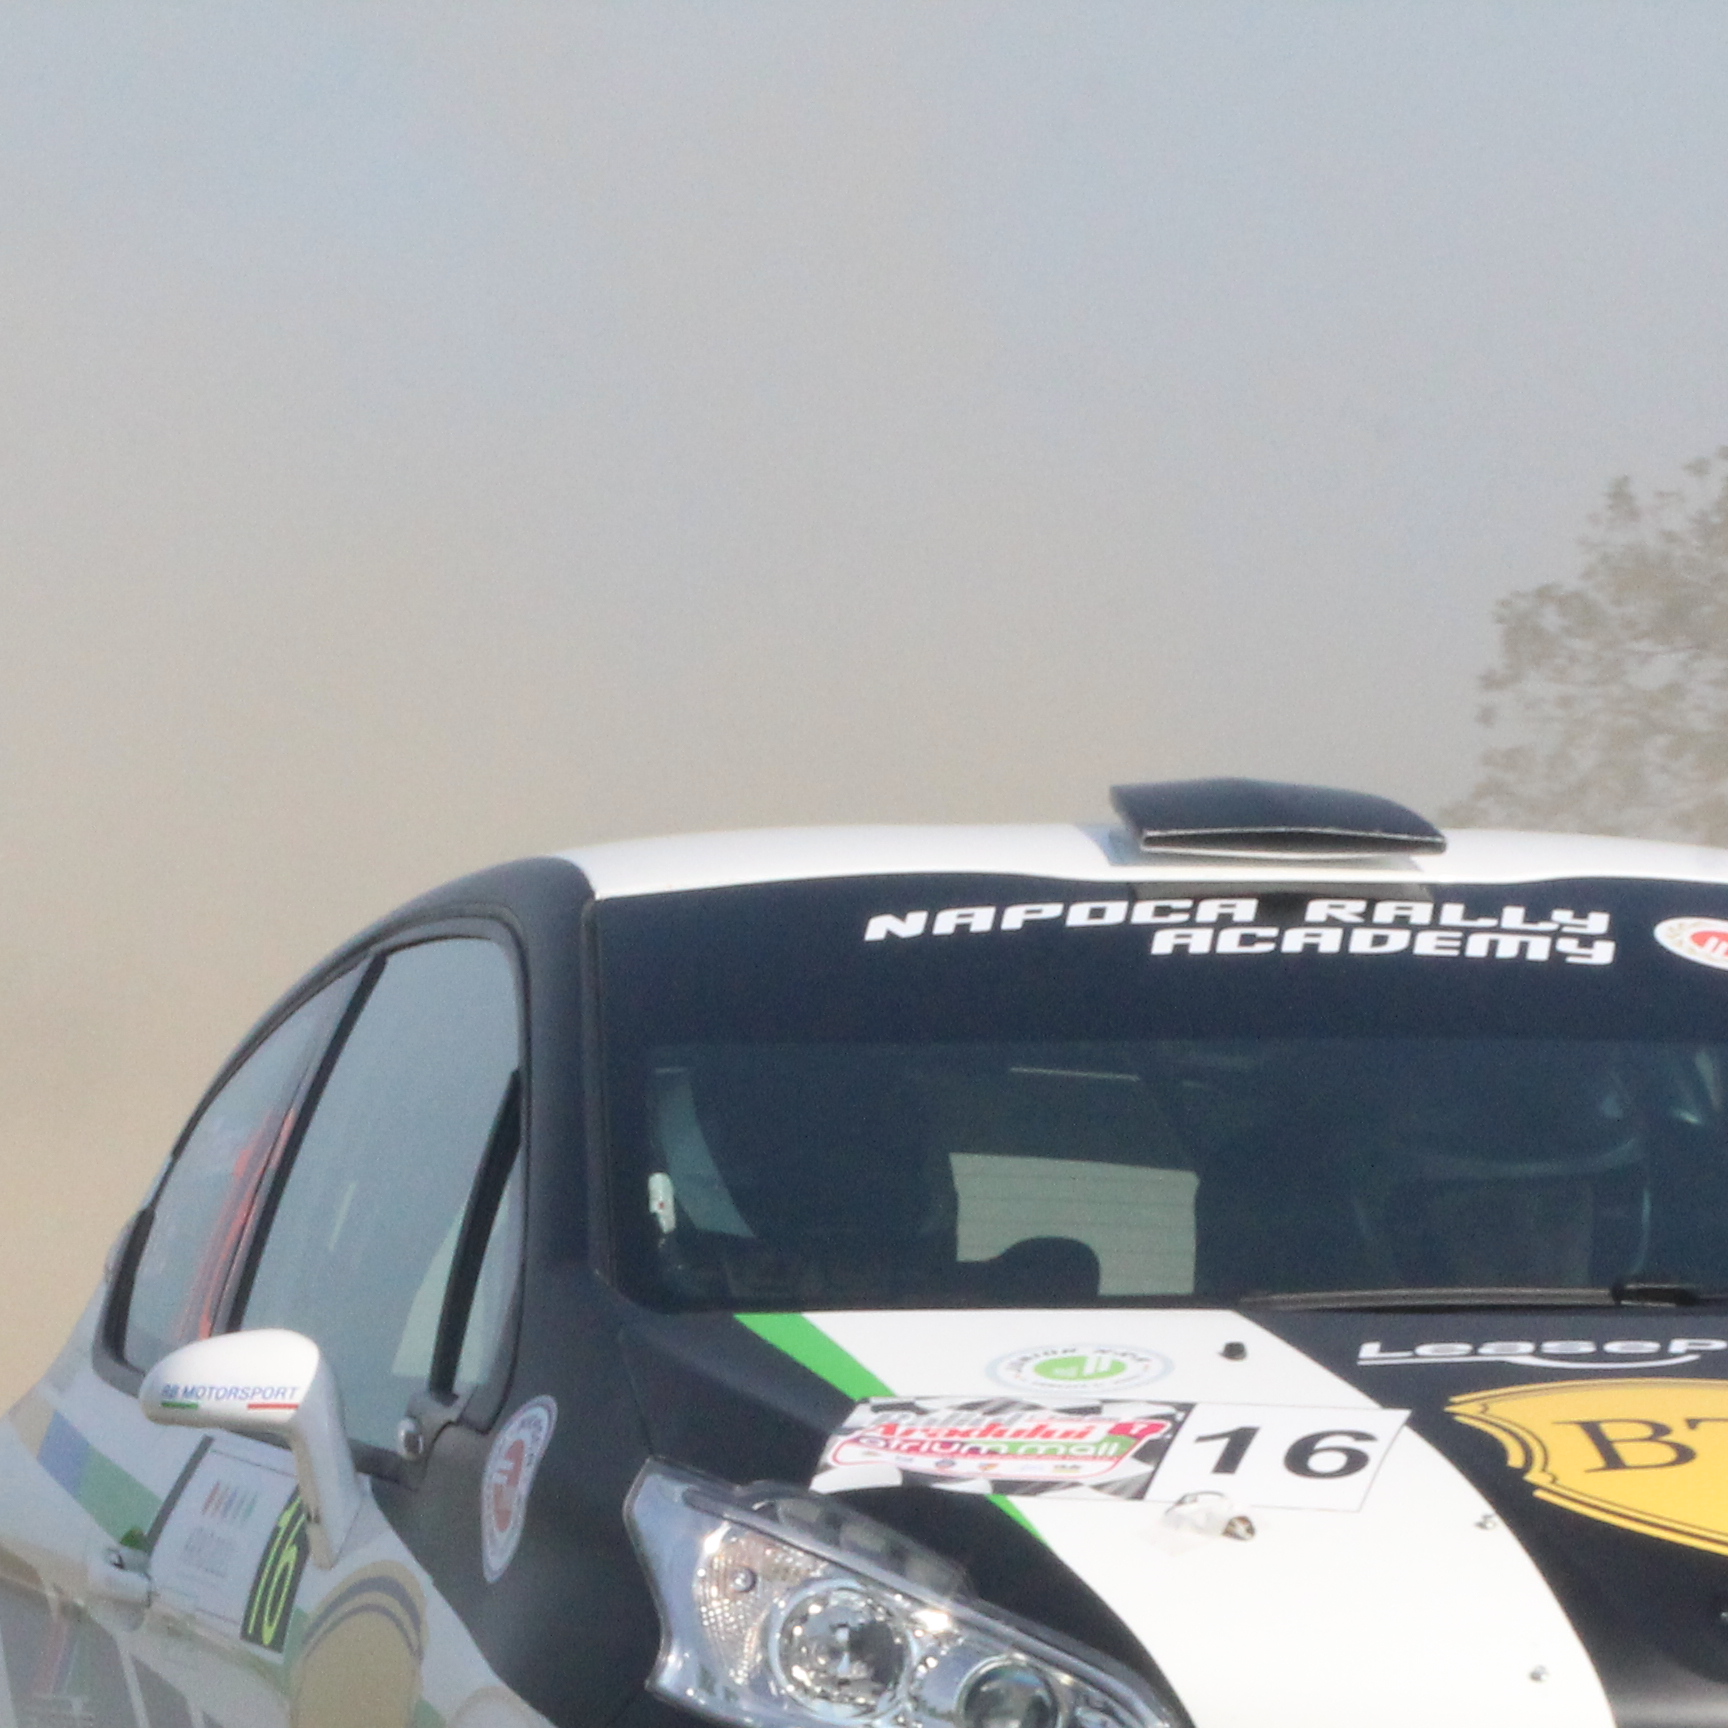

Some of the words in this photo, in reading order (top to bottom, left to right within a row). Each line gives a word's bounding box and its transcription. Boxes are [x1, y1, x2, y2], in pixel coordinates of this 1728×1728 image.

[864, 898, 1259, 941] NAPOCA
[1305, 898, 1610, 935] RALLY
[1150, 926, 1615, 965] ACADEMY
[182, 1385, 300, 1401] MOTORSPORT
[860, 1421, 1096, 1439] Aradului
[858, 1437, 1010, 1455] atrium
[1017, 1442, 1119, 1456] mall
[1193, 1425, 1378, 1479] 16
